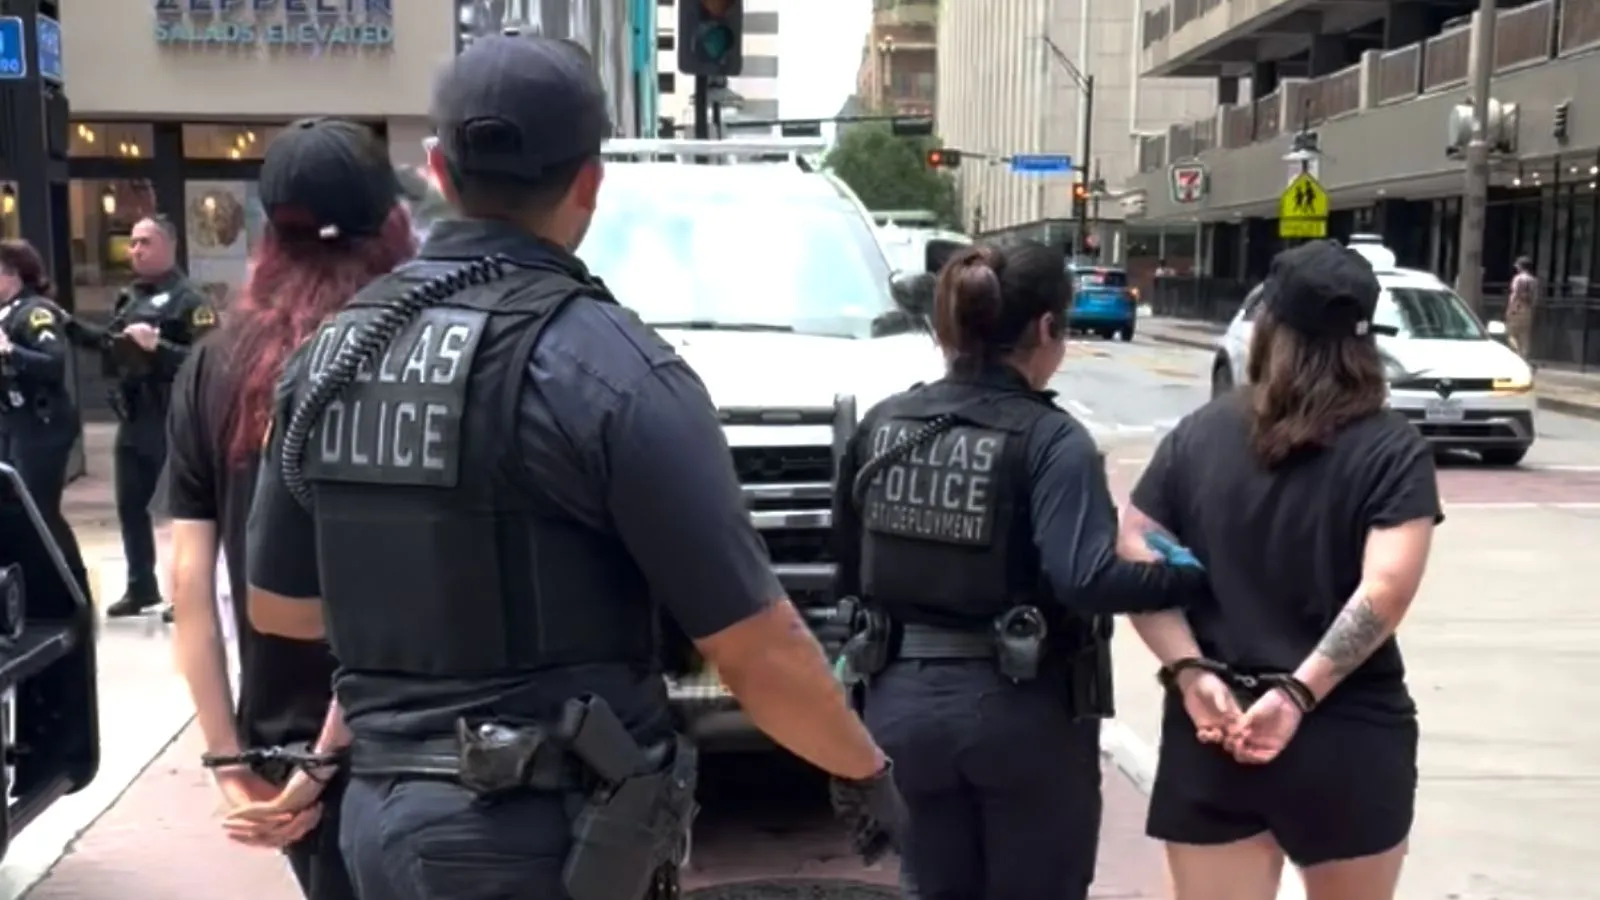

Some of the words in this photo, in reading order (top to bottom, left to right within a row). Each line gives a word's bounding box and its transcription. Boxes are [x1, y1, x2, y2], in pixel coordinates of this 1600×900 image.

[155, 24, 256, 42] SALADS
[266, 25, 394, 44] ELEVATED
[309, 400, 448, 469] OLICE
